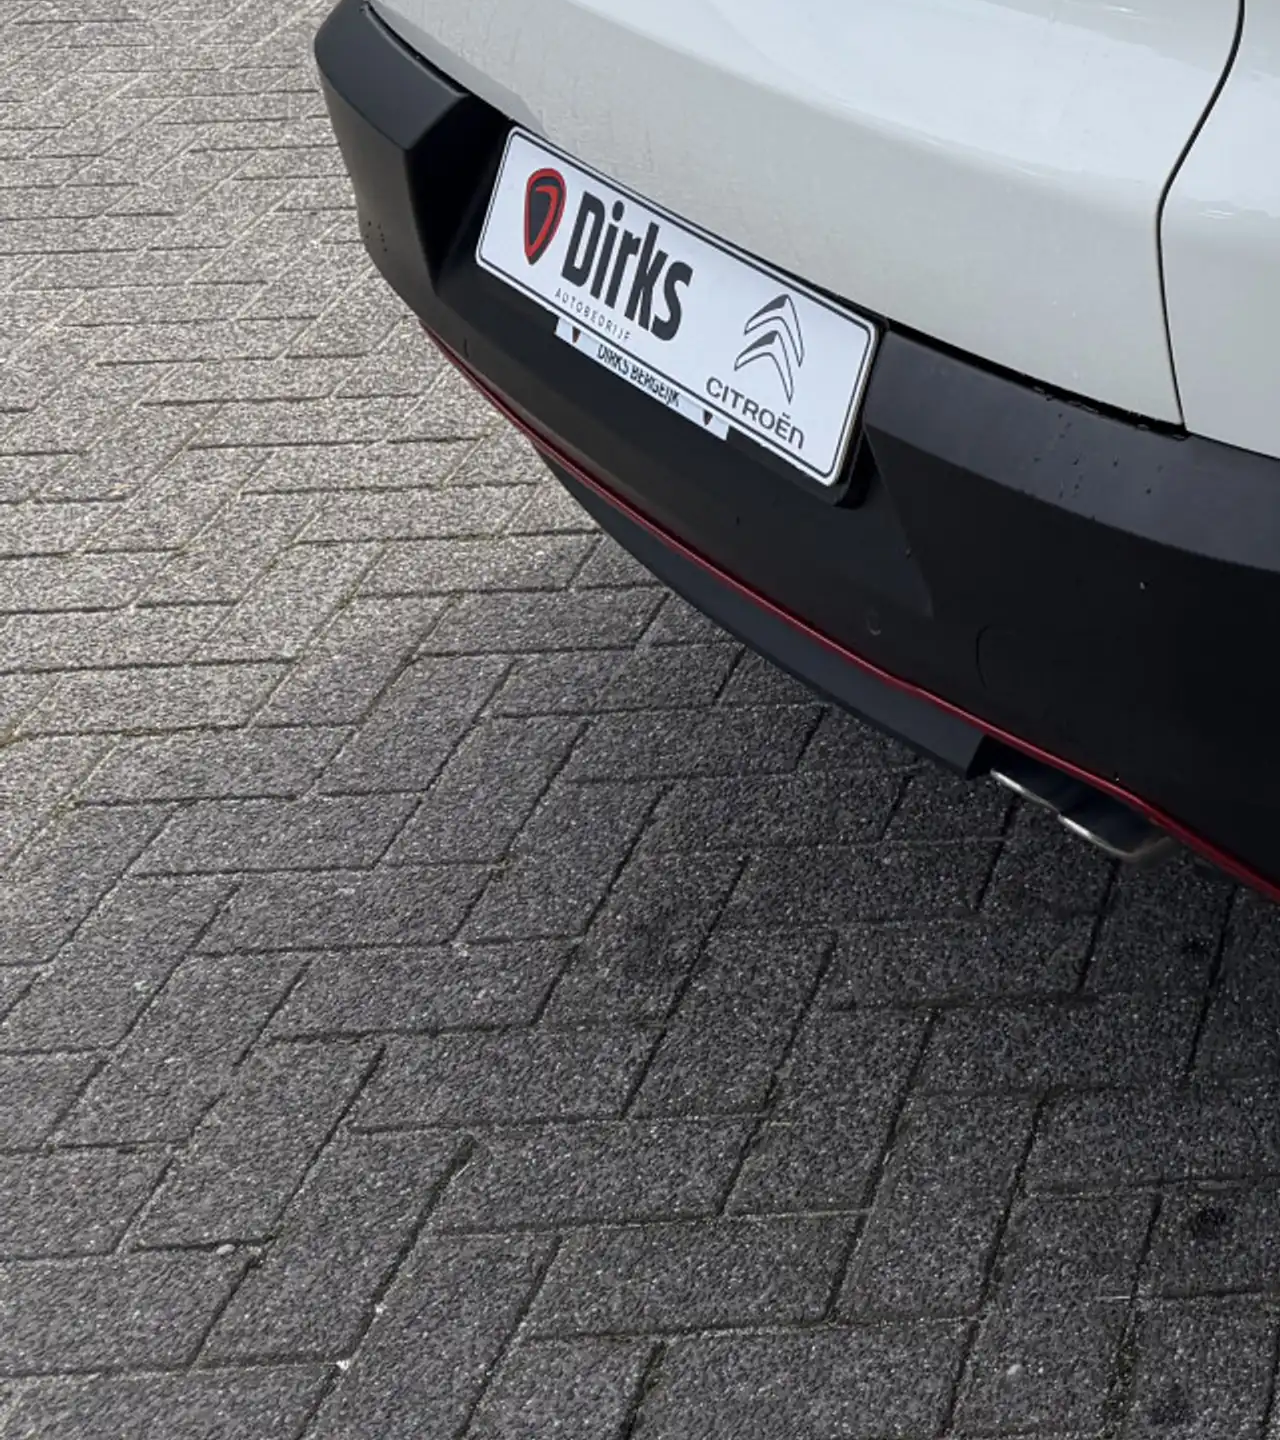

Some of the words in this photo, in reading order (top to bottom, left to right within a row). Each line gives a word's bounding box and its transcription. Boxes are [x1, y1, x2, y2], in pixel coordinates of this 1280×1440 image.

[561, 190, 693, 341] Dirks
[554, 287, 632, 342] AUTOBEDRIJF
[596, 342, 630, 376] DIRKS
